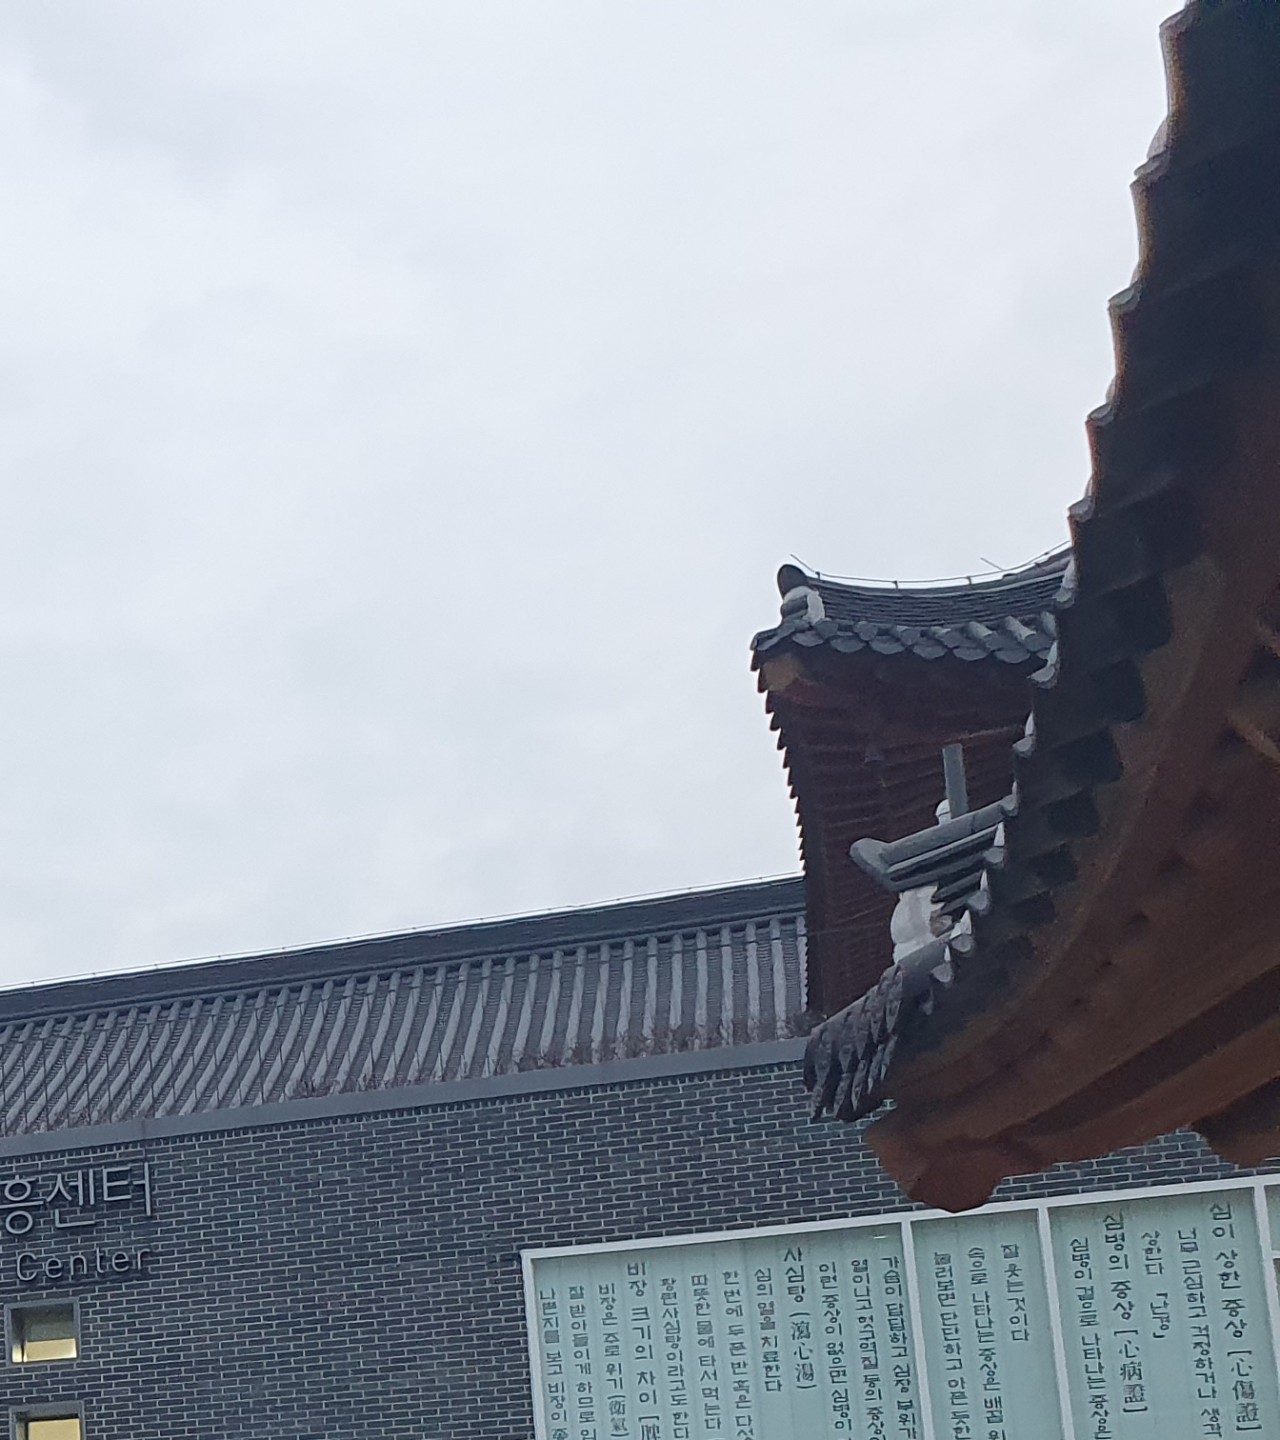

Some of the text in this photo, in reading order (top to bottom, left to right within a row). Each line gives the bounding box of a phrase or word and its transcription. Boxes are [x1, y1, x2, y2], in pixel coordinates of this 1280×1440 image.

[1102, 1211, 1129, 1270] 심병의
[1209, 1202, 1235, 1239] 심이
[16, 1246, 153, 1282] Center
[967, 1247, 988, 1285] 속으로
[1000, 1243, 1019, 1259] 잘
[1069, 1236, 1092, 1280] 심병이
[1140, 1230, 1164, 1275] 상한다
[1215, 1249, 1242, 1289] 상한
[627, 1262, 647, 1297] 비장
[690, 1273, 711, 1316] 따뜻한
[783, 1246, 806, 1303] 사심탕
[818, 1261, 838, 1289] 이런
[879, 1255, 902, 1297] 가슴이
[1181, 1259, 1207, 1318] 근심하고
[598, 1282, 618, 1326] 비장은
[821, 1293, 842, 1336] 증상이
[971, 1290, 995, 1343] 나타나는
[1006, 1296, 1030, 1341] 것이다
[1110, 1280, 1134, 1320] 증상
[1221, 1298, 1248, 1338] 증상
[569, 1304, 591, 1375] 받아들이게
[602, 1332, 620, 1356] 주로
[630, 1306, 653, 1360] 크기의
[696, 1320, 714, 1348] 물에
[727, 1324, 744, 1336] 두
[754, 1267, 782, 1392] 심의 열을 치료한다
[885, 1301, 909, 1358] 답답하고
[939, 1311, 963, 1370] 단단하고
[545, 1350, 563, 1376] 보고
[698, 1354, 717, 1382] 타서
[730, 1360, 748, 1375] 반
[825, 1341, 848, 1384] 없으면
[892, 1362, 914, 1393] 심장
[978, 1347, 1001, 1391] 증상은
[1081, 1332, 1106, 1390] 나타나는
[1189, 1324, 1217, 1398] 걱정하거나
[547, 1381, 567, 1422] 비장이
[575, 1381, 596, 1423] 하므로
[636, 1370, 657, 1405] 차이
[732, 1379, 752, 1409] 혹은
[862, 1373, 882, 1401] 등의
[947, 1376, 968, 1406] 아픈
[672, 1411, 689, 1439] 한다
[701, 1386, 721, 1430] 먹는다
[831, 1388, 852, 1431] 심병이
[896, 1398, 917, 1439] 부위가
[950, 1410, 972, 1440] 듯한
[983, 1395, 1003, 1424] 배꼽
[1088, 1393, 1112, 1440] 증상은
